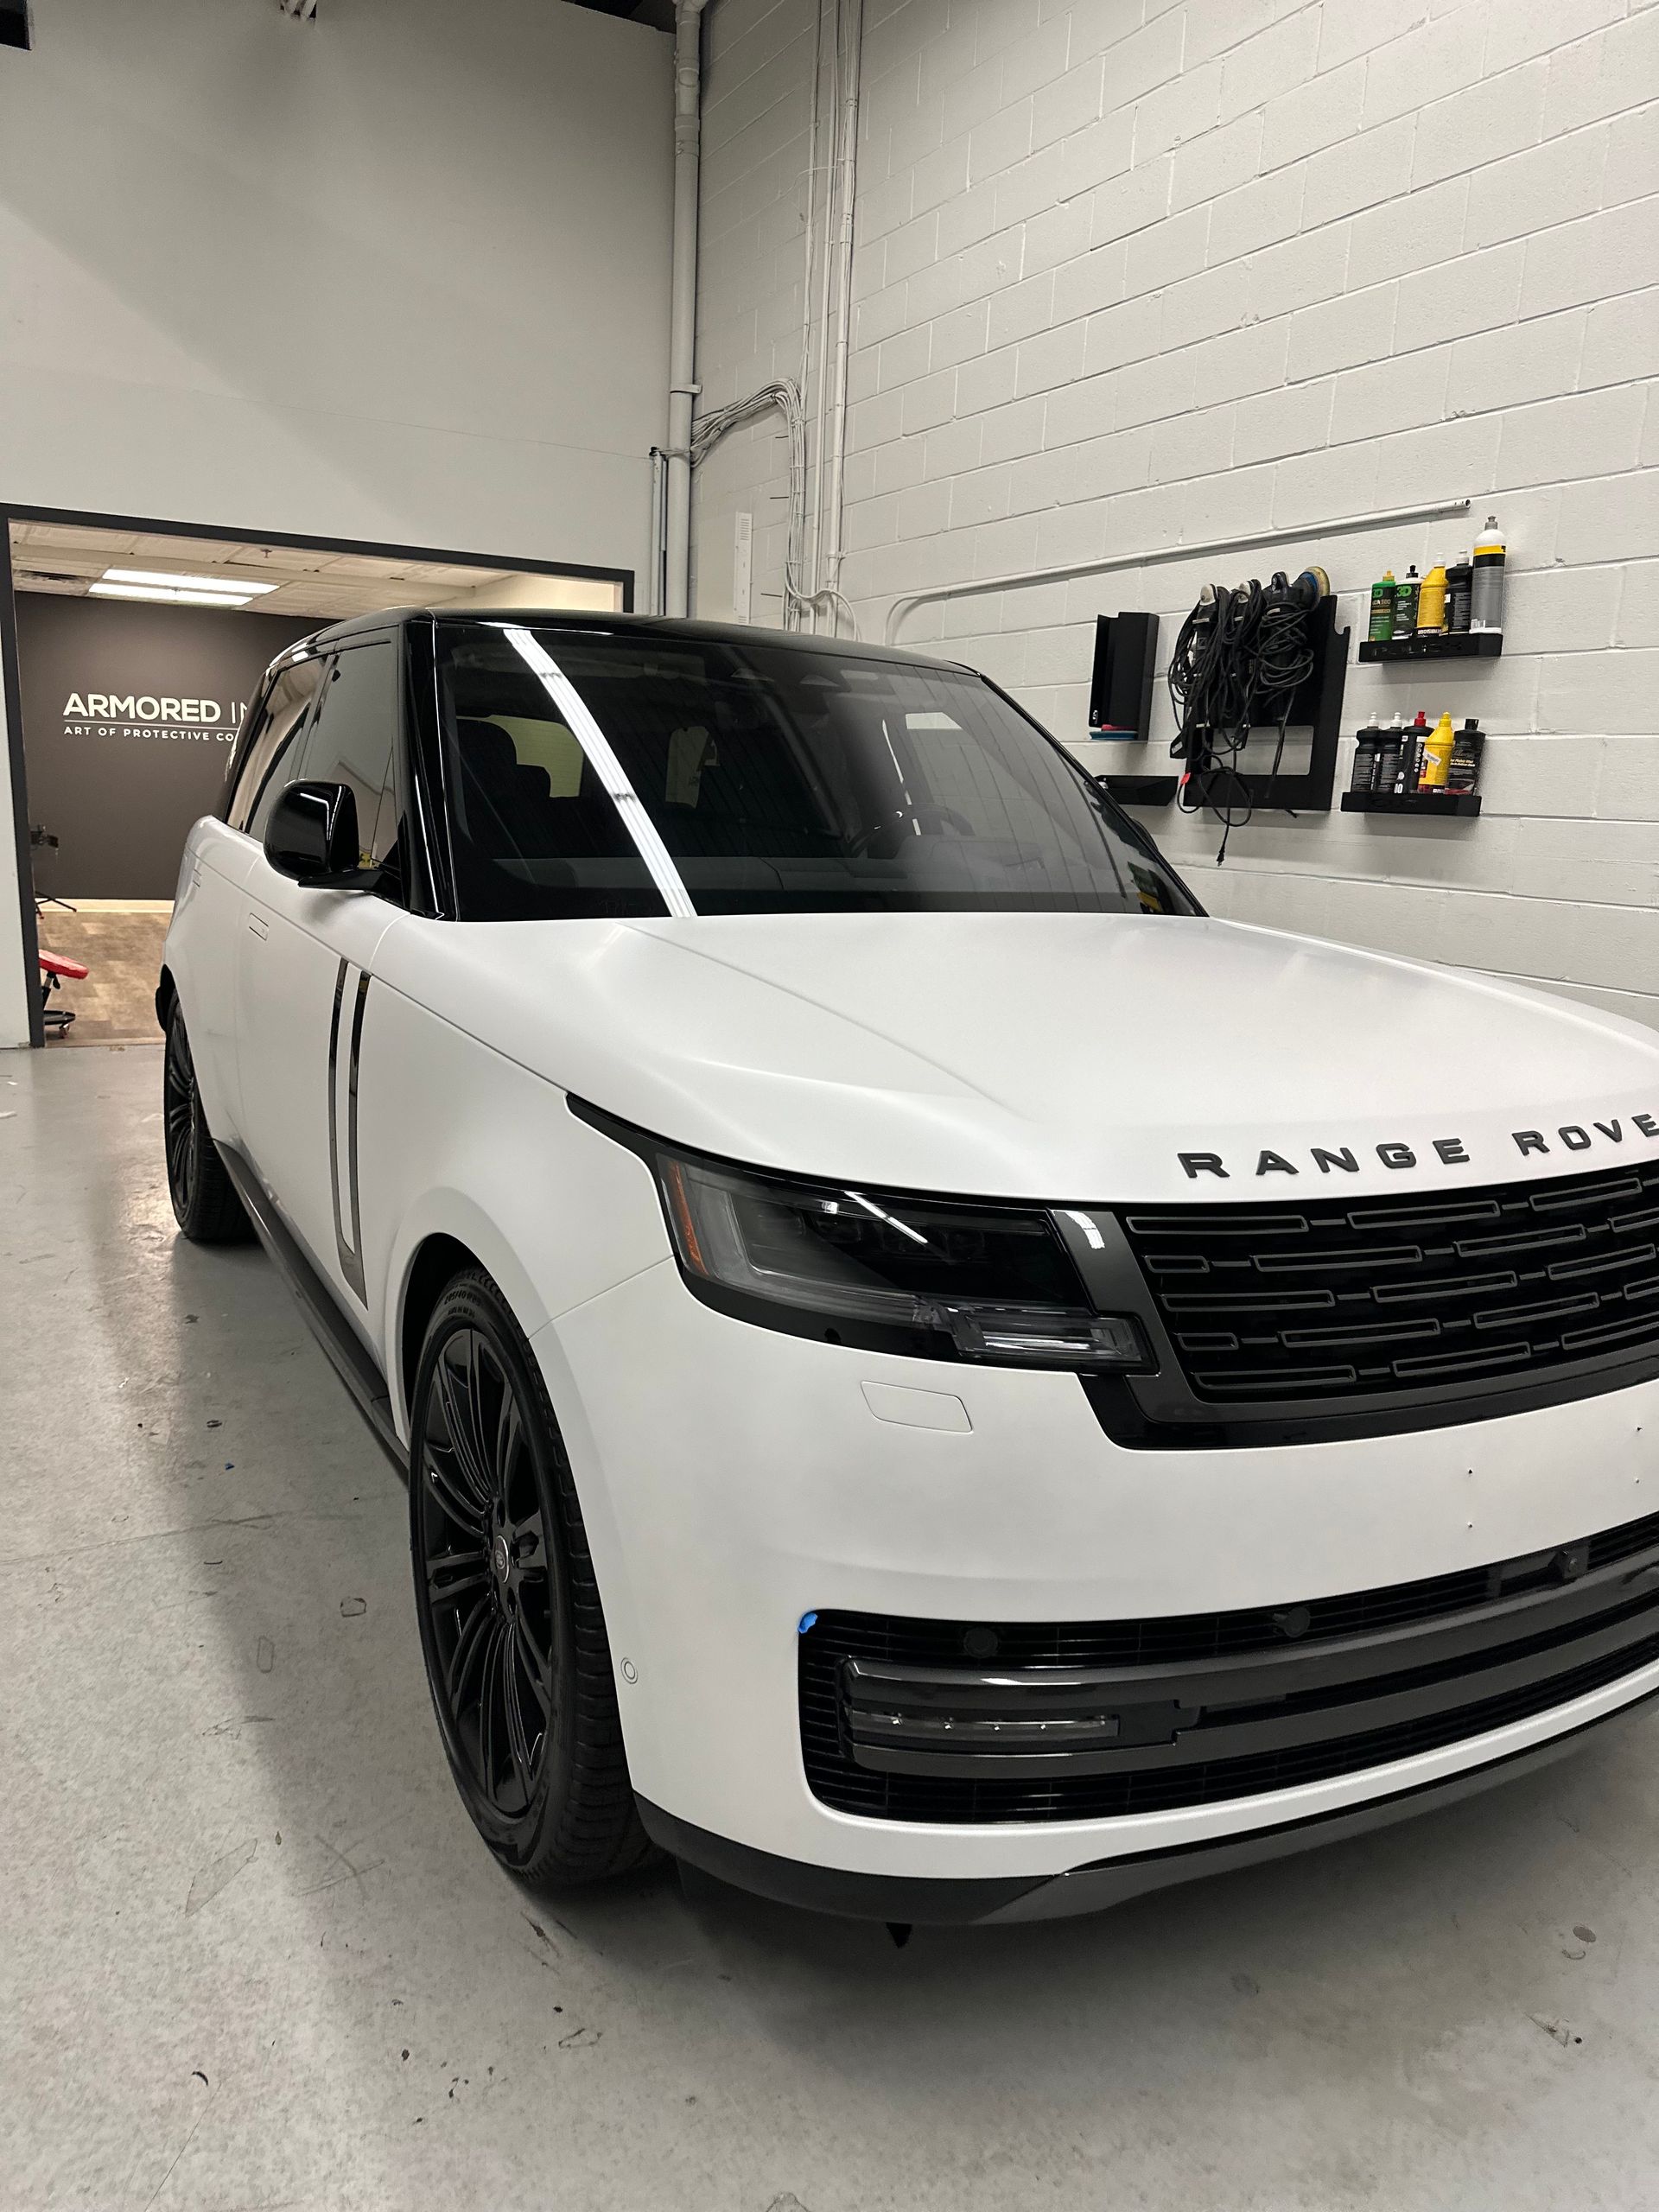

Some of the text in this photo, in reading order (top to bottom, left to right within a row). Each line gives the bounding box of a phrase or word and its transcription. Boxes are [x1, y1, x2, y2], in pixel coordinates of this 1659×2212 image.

[62, 692, 221, 723] ARMORED
[63, 726, 234, 742] ART OF PROTECTIVE CO
[1177, 1138, 1471, 1178] RANGE
